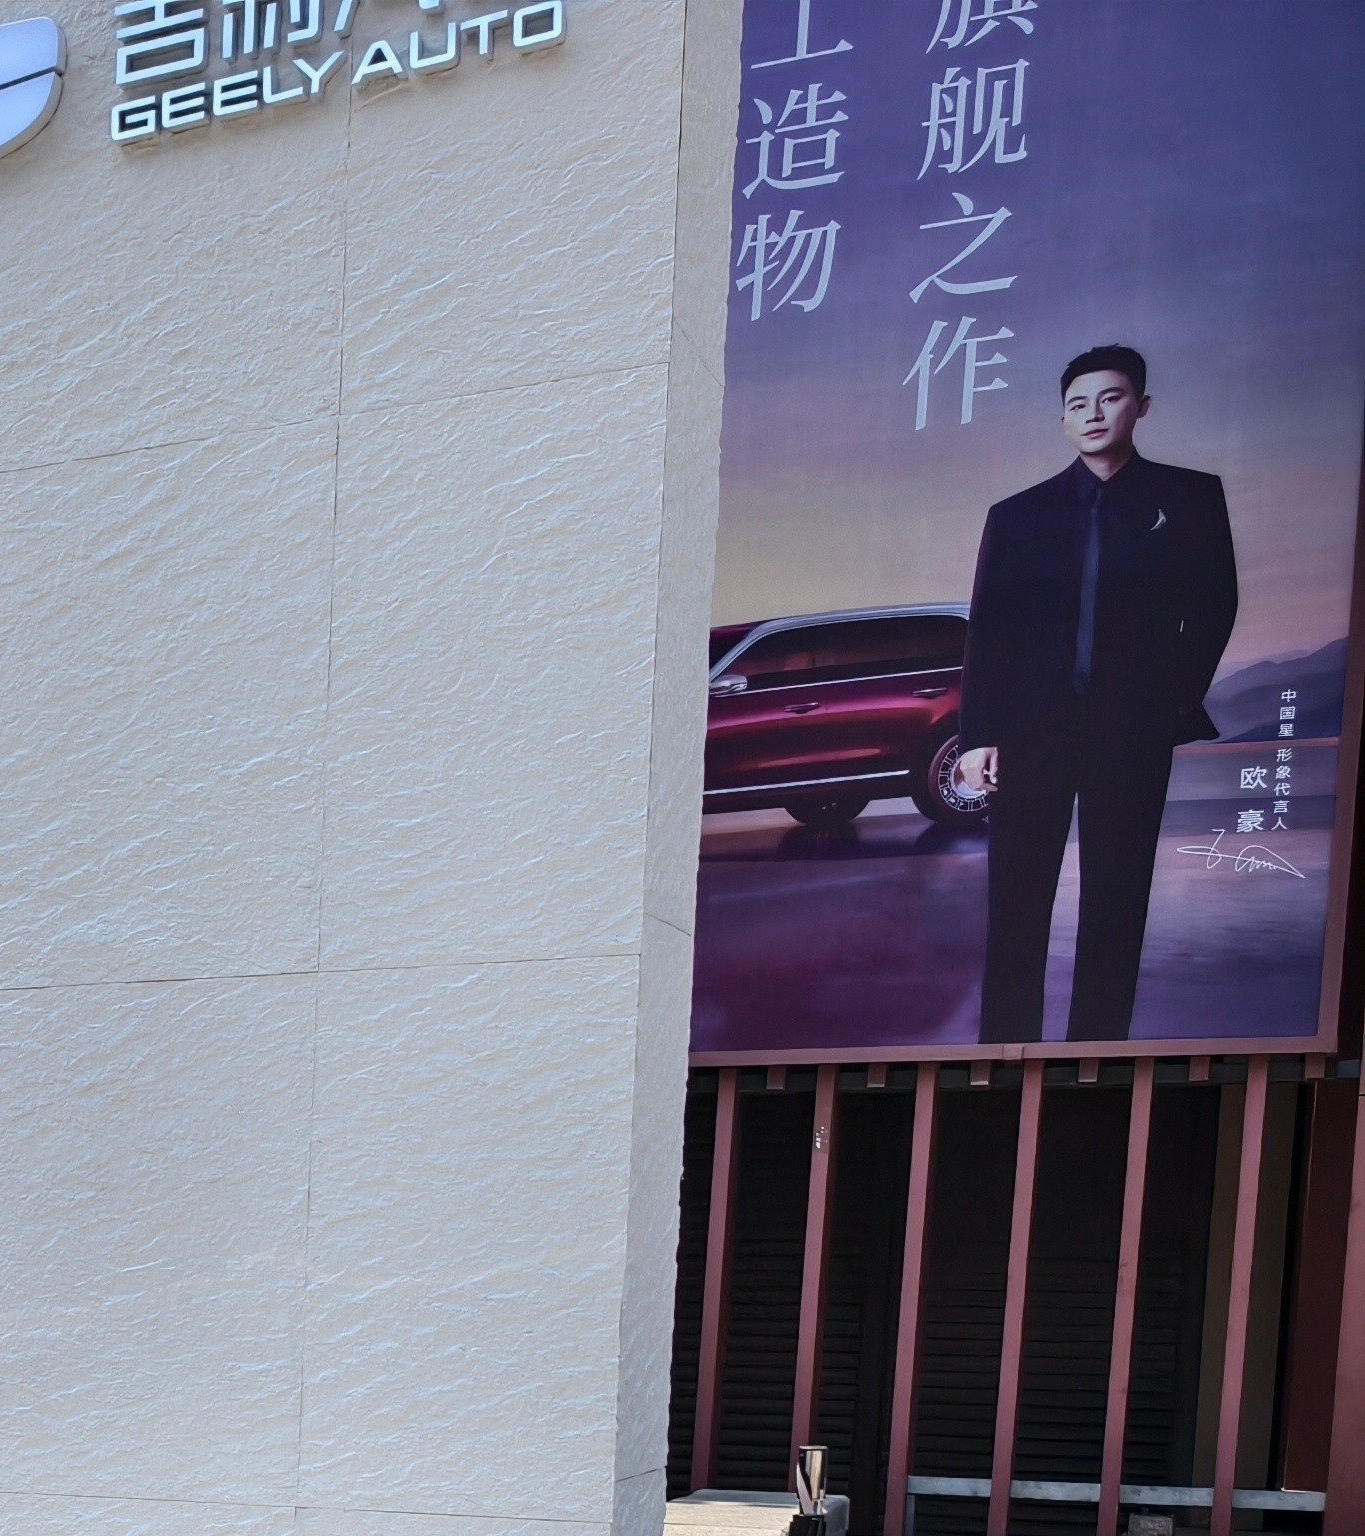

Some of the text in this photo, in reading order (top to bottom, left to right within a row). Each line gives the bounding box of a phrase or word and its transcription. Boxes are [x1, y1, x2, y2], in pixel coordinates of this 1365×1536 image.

[111, 0, 565, 142] GEELY AUTO
[1236, 766, 1267, 833] 欧豪
